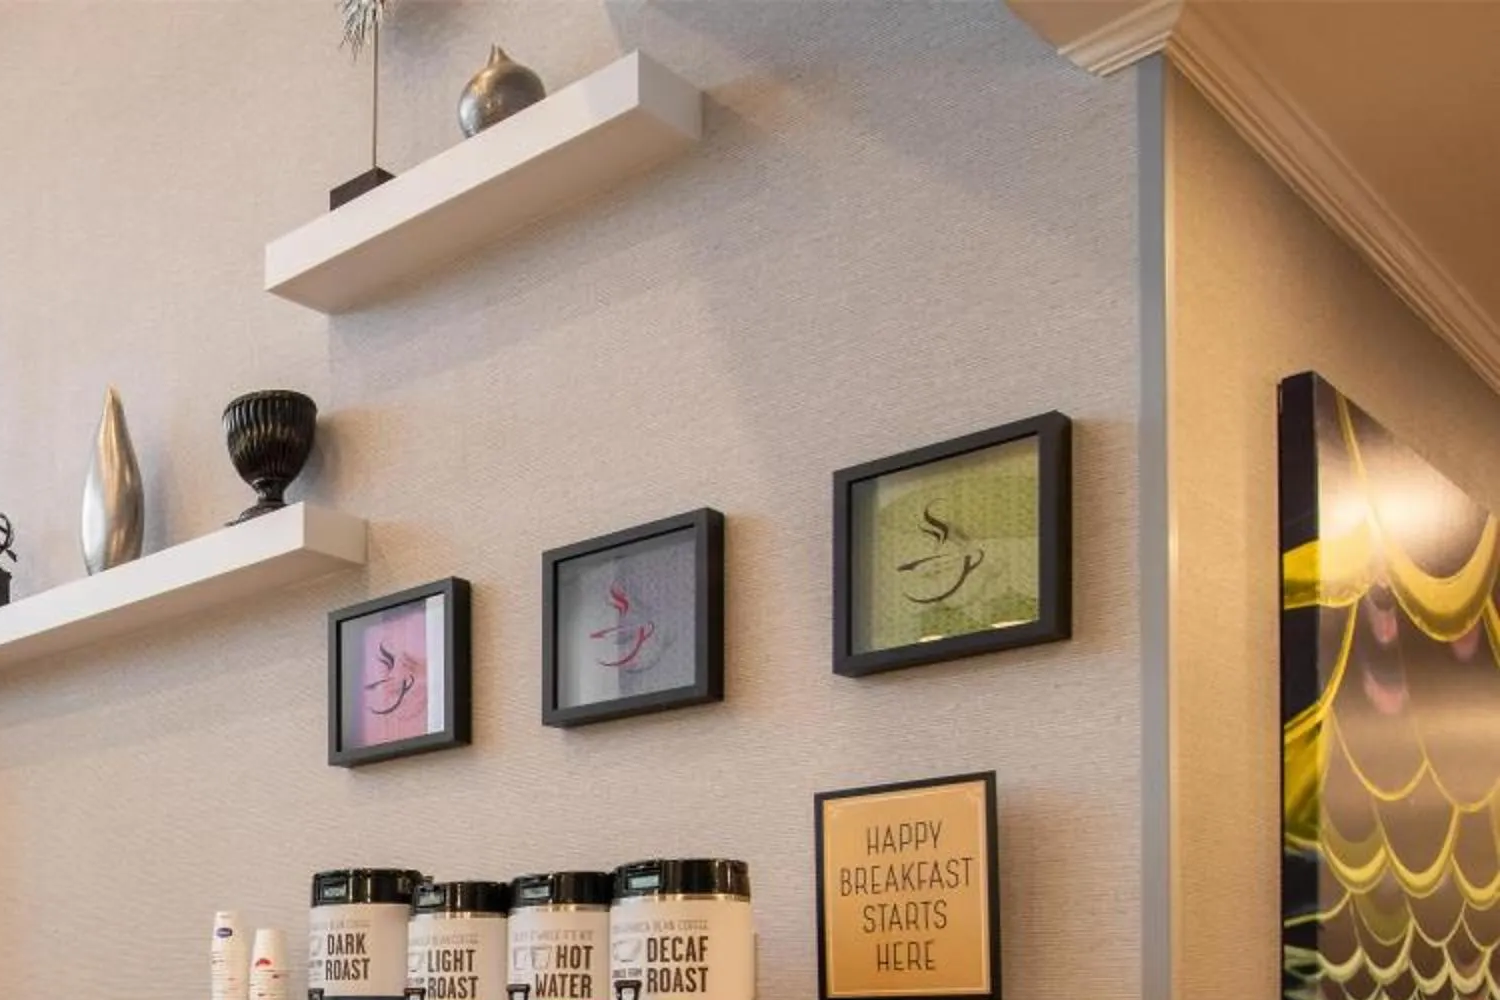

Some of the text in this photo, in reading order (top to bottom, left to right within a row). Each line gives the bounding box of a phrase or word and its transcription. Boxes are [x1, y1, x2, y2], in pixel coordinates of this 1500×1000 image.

[867, 819, 942, 855] HAPPY
[840, 856, 974, 897] BREAKFAST
[863, 899, 948, 933] STARTS
[327, 932, 367, 955] DARK
[646, 936, 709, 963] DECAF
[876, 940, 937, 972] HERE
[325, 957, 371, 980] ROAST
[427, 948, 476, 973] LIGHT
[556, 944, 594, 970] HOT
[427, 975, 479, 1000] ROAST
[535, 972, 593, 998] WATER
[646, 966, 709, 993] ROAST
